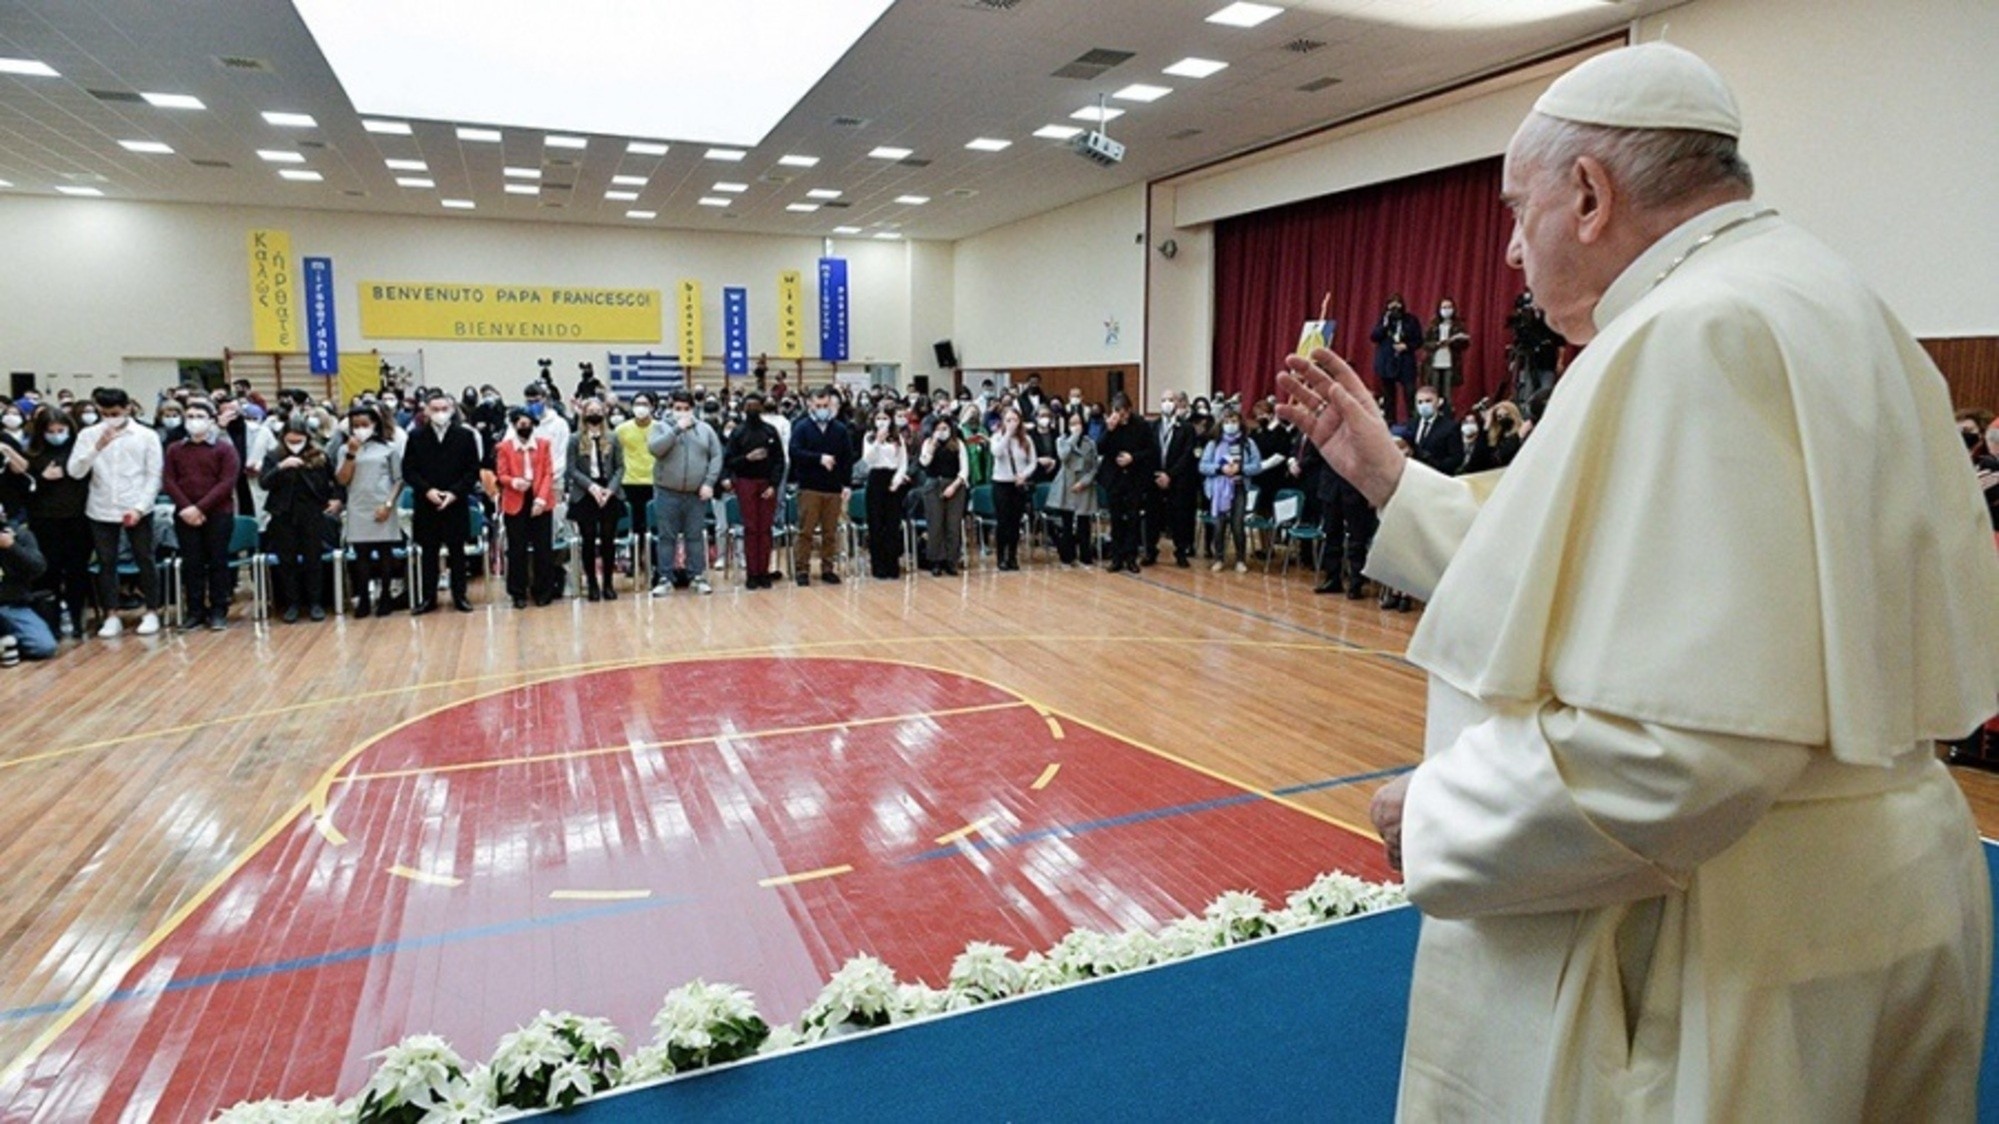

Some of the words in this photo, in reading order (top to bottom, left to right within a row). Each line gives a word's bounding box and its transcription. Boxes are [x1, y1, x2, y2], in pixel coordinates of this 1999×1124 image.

[372, 285, 484, 302] BENVENUTO
[496, 289, 541, 303] PAPA
[552, 290, 650, 307] FRANCESCO!
[454, 321, 582, 337] BIENVENIDO
[730, 293, 743, 370] welcome
